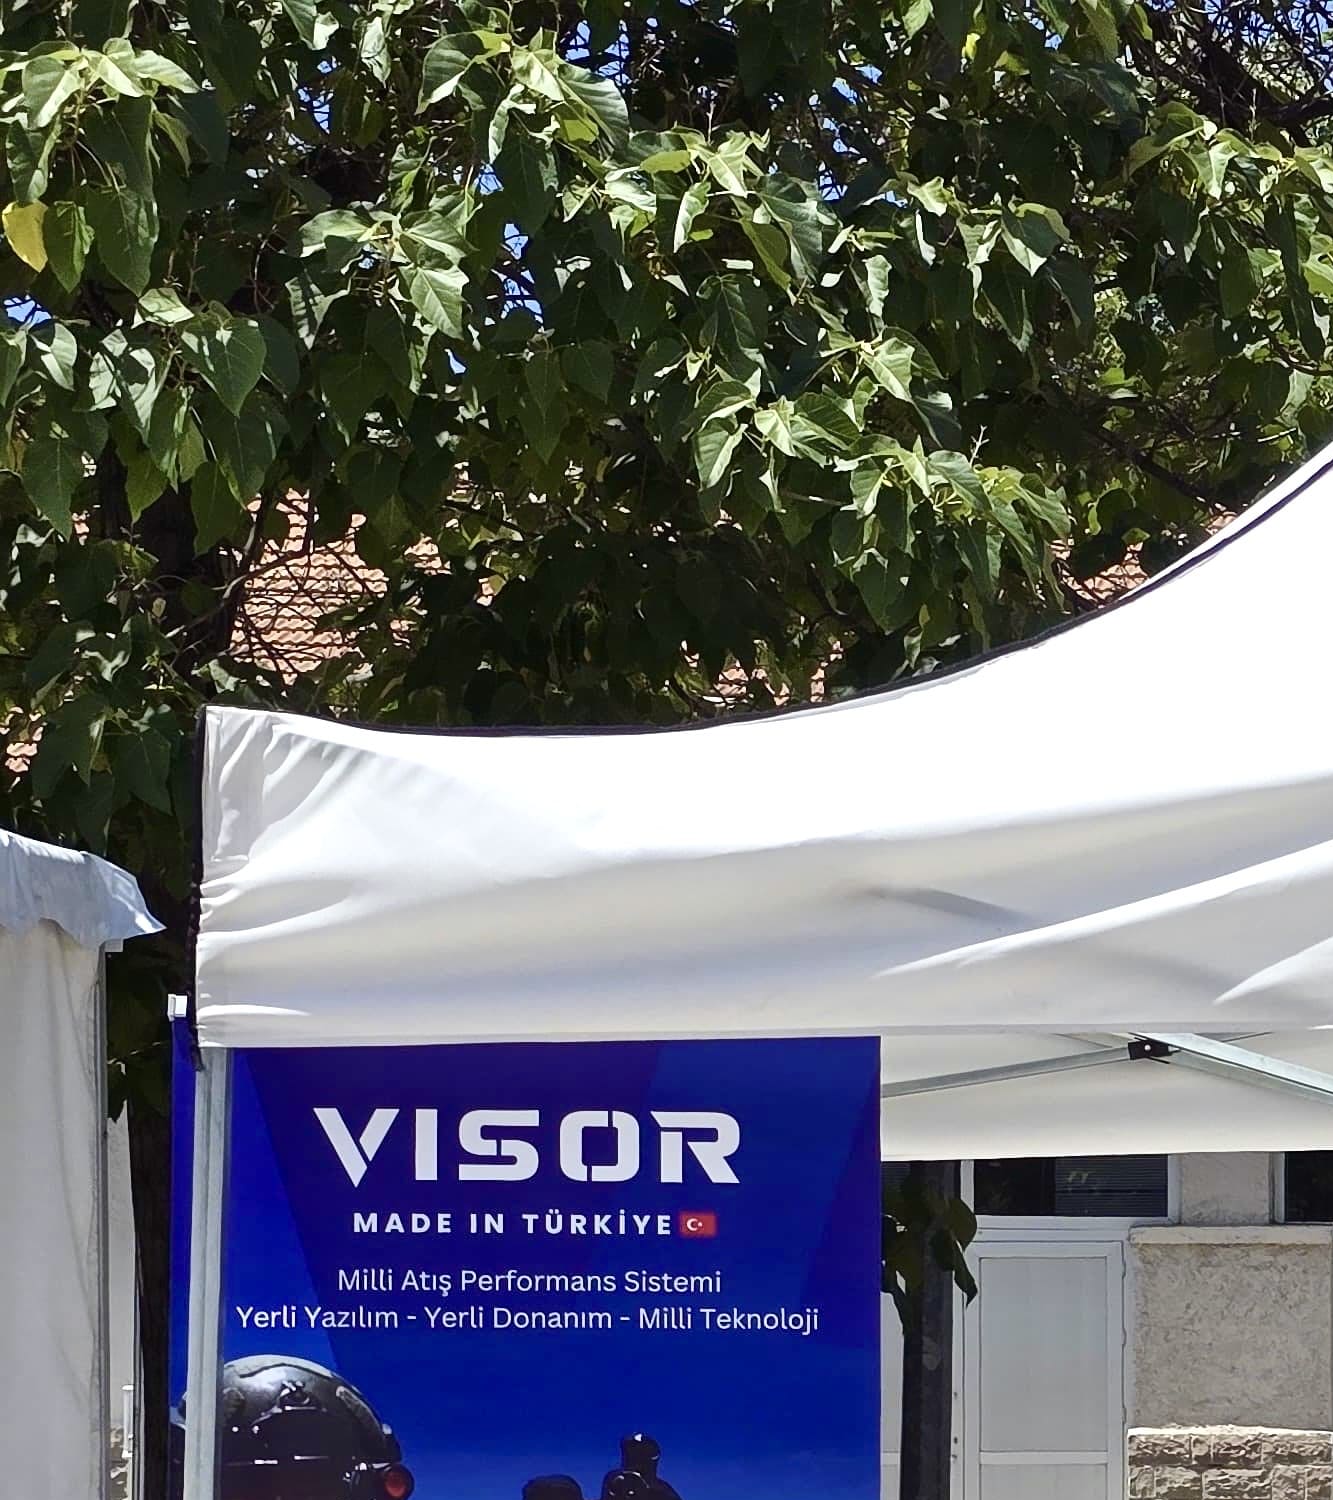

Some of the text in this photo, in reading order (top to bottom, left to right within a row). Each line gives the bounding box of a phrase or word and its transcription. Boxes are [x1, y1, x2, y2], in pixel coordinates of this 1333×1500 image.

[314, 1108, 740, 1189] VISOR
[354, 1208, 671, 1236] MADE IN TÜRKİYE
[338, 1268, 721, 1296] Milli Atış Performans Sistemi
[236, 1305, 296, 1329] Yerli
[304, 1306, 399, 1329] Yazılım
[424, 1305, 486, 1330] Yerli
[494, 1306, 612, 1330] Donanım
[639, 1305, 692, 1330] Milli
[700, 1305, 819, 1335] Teknoloji
